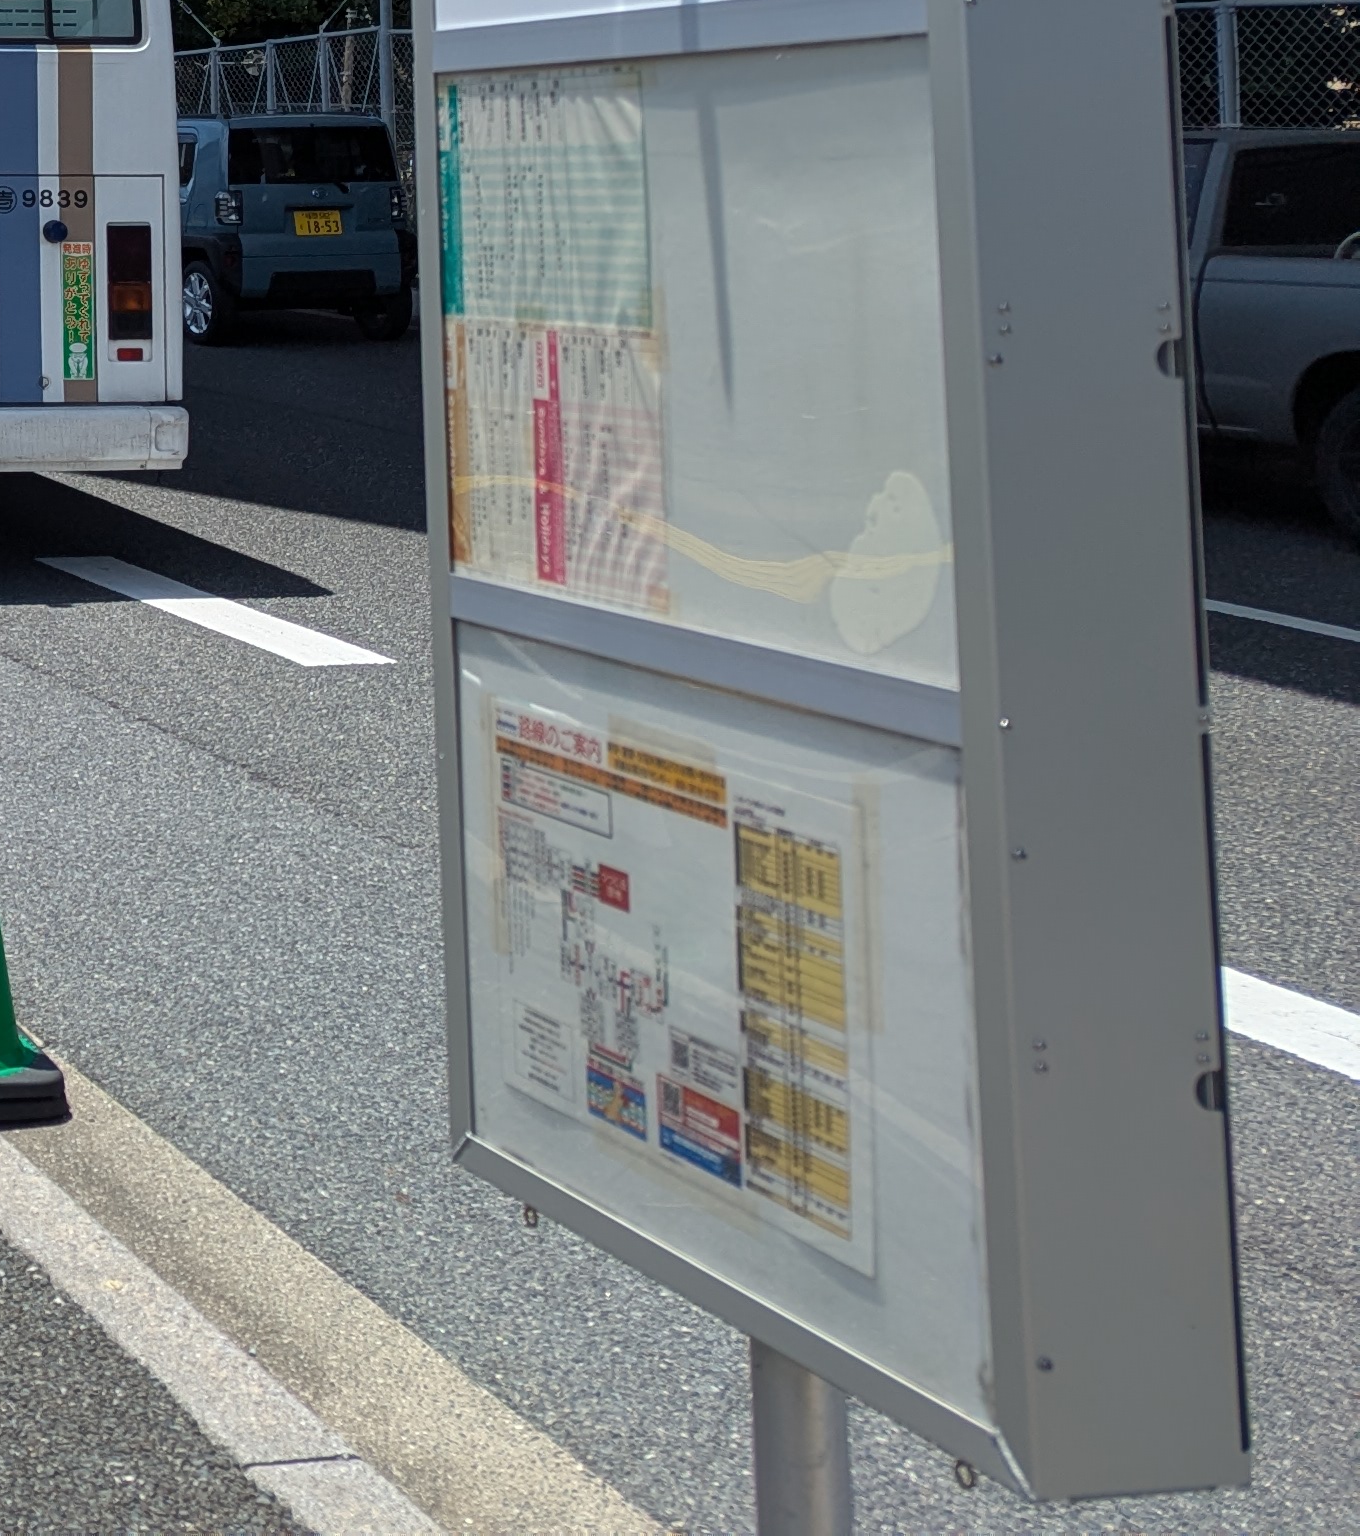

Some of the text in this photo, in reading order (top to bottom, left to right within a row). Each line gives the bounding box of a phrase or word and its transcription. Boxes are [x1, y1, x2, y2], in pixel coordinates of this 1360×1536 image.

[22, 189, 89, 209] 9839
[307, 219, 340, 234] 18-53
[538, 407, 547, 476] Sundays
[539, 501, 552, 573] Holidays
